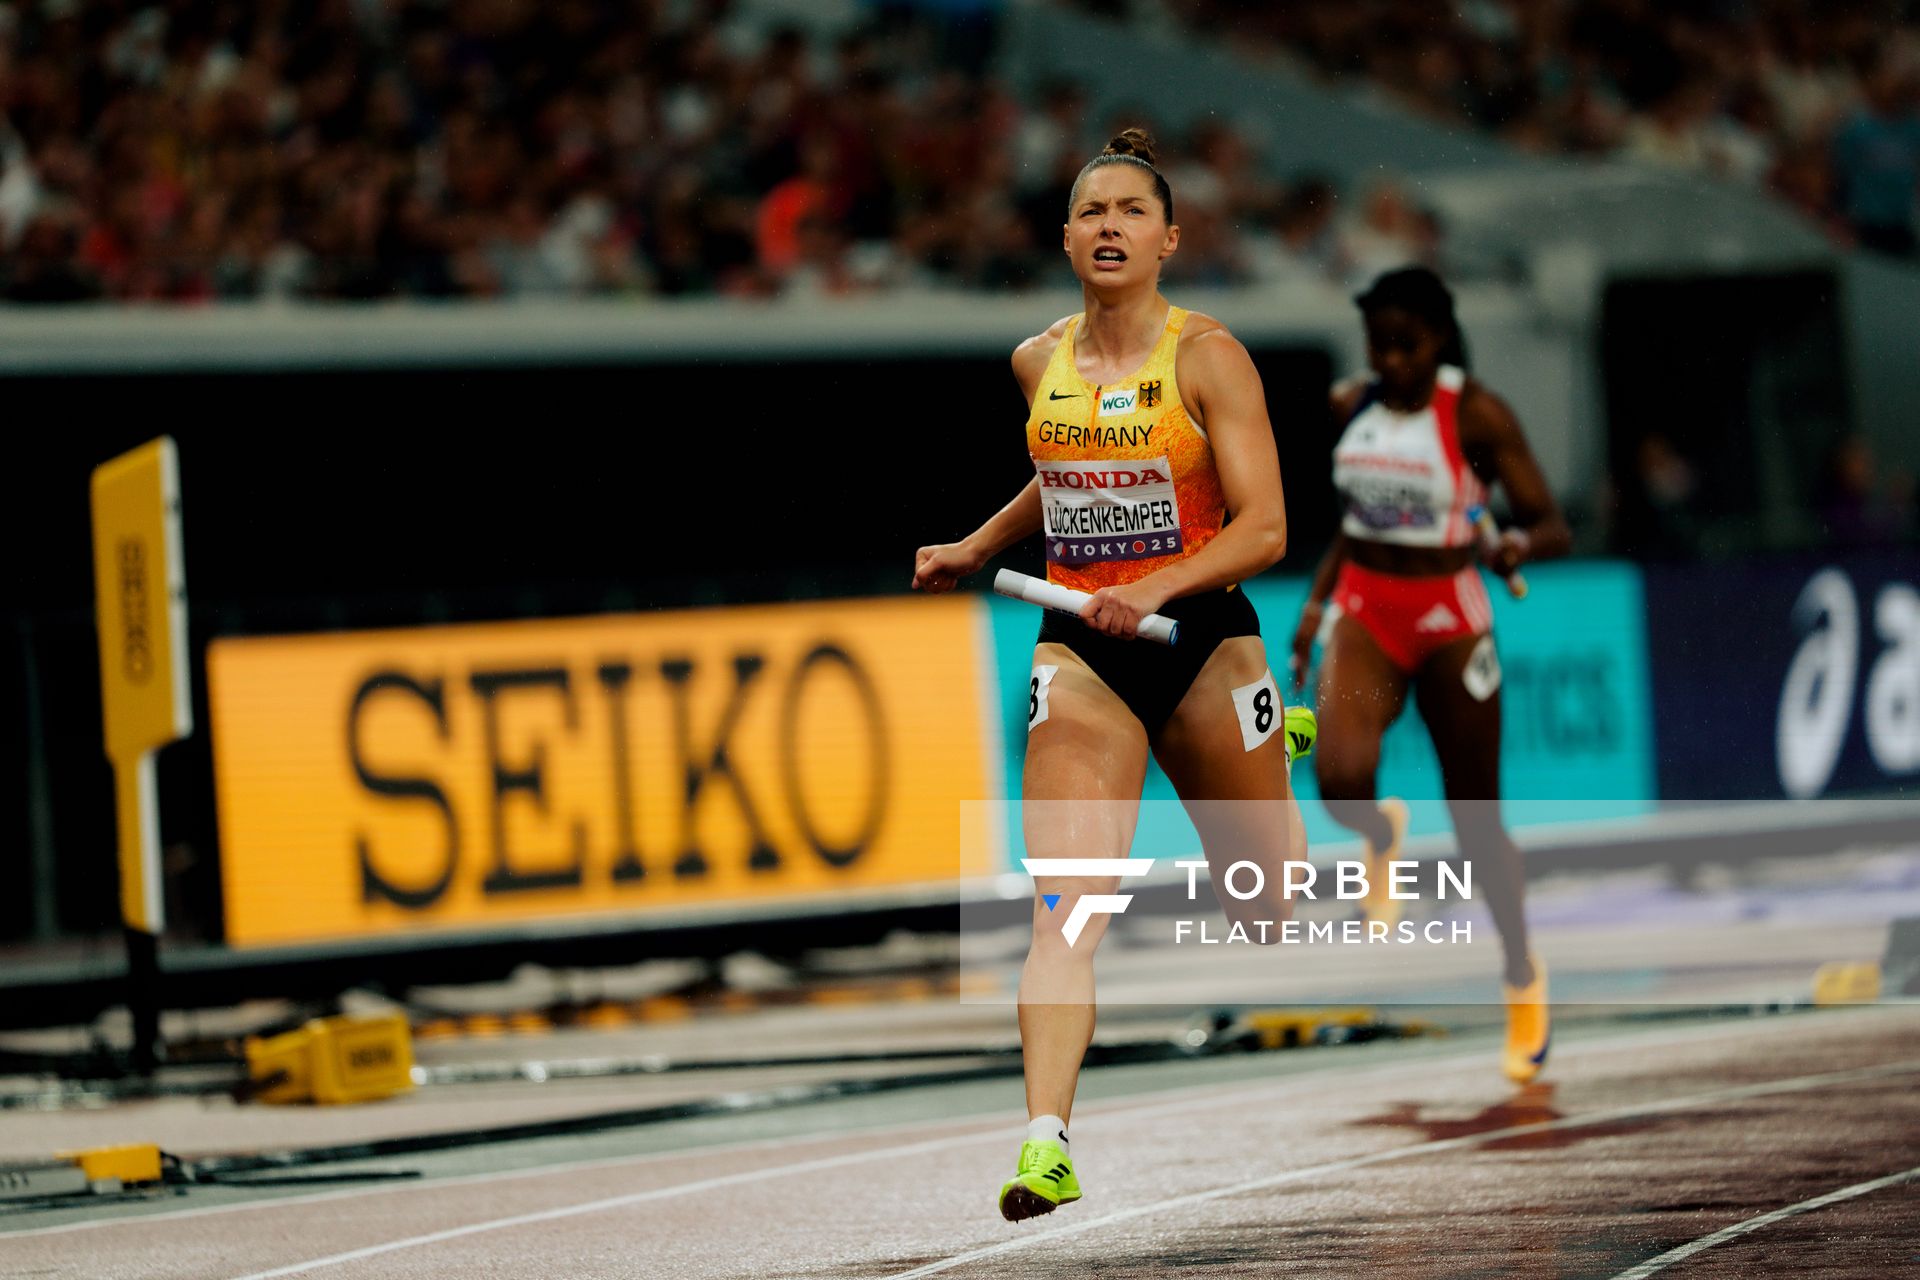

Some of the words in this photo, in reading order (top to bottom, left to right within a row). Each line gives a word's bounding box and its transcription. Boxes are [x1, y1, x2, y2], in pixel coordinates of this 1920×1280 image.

[1102, 394, 1135, 411] WGV
[1039, 420, 1153, 448] GERMANY
[1040, 468, 1169, 489] HONDA
[1047, 499, 1175, 534] LÜCKENKEMPER
[1253, 687, 1273, 733] 8
[347, 639, 889, 910] SEIKO
